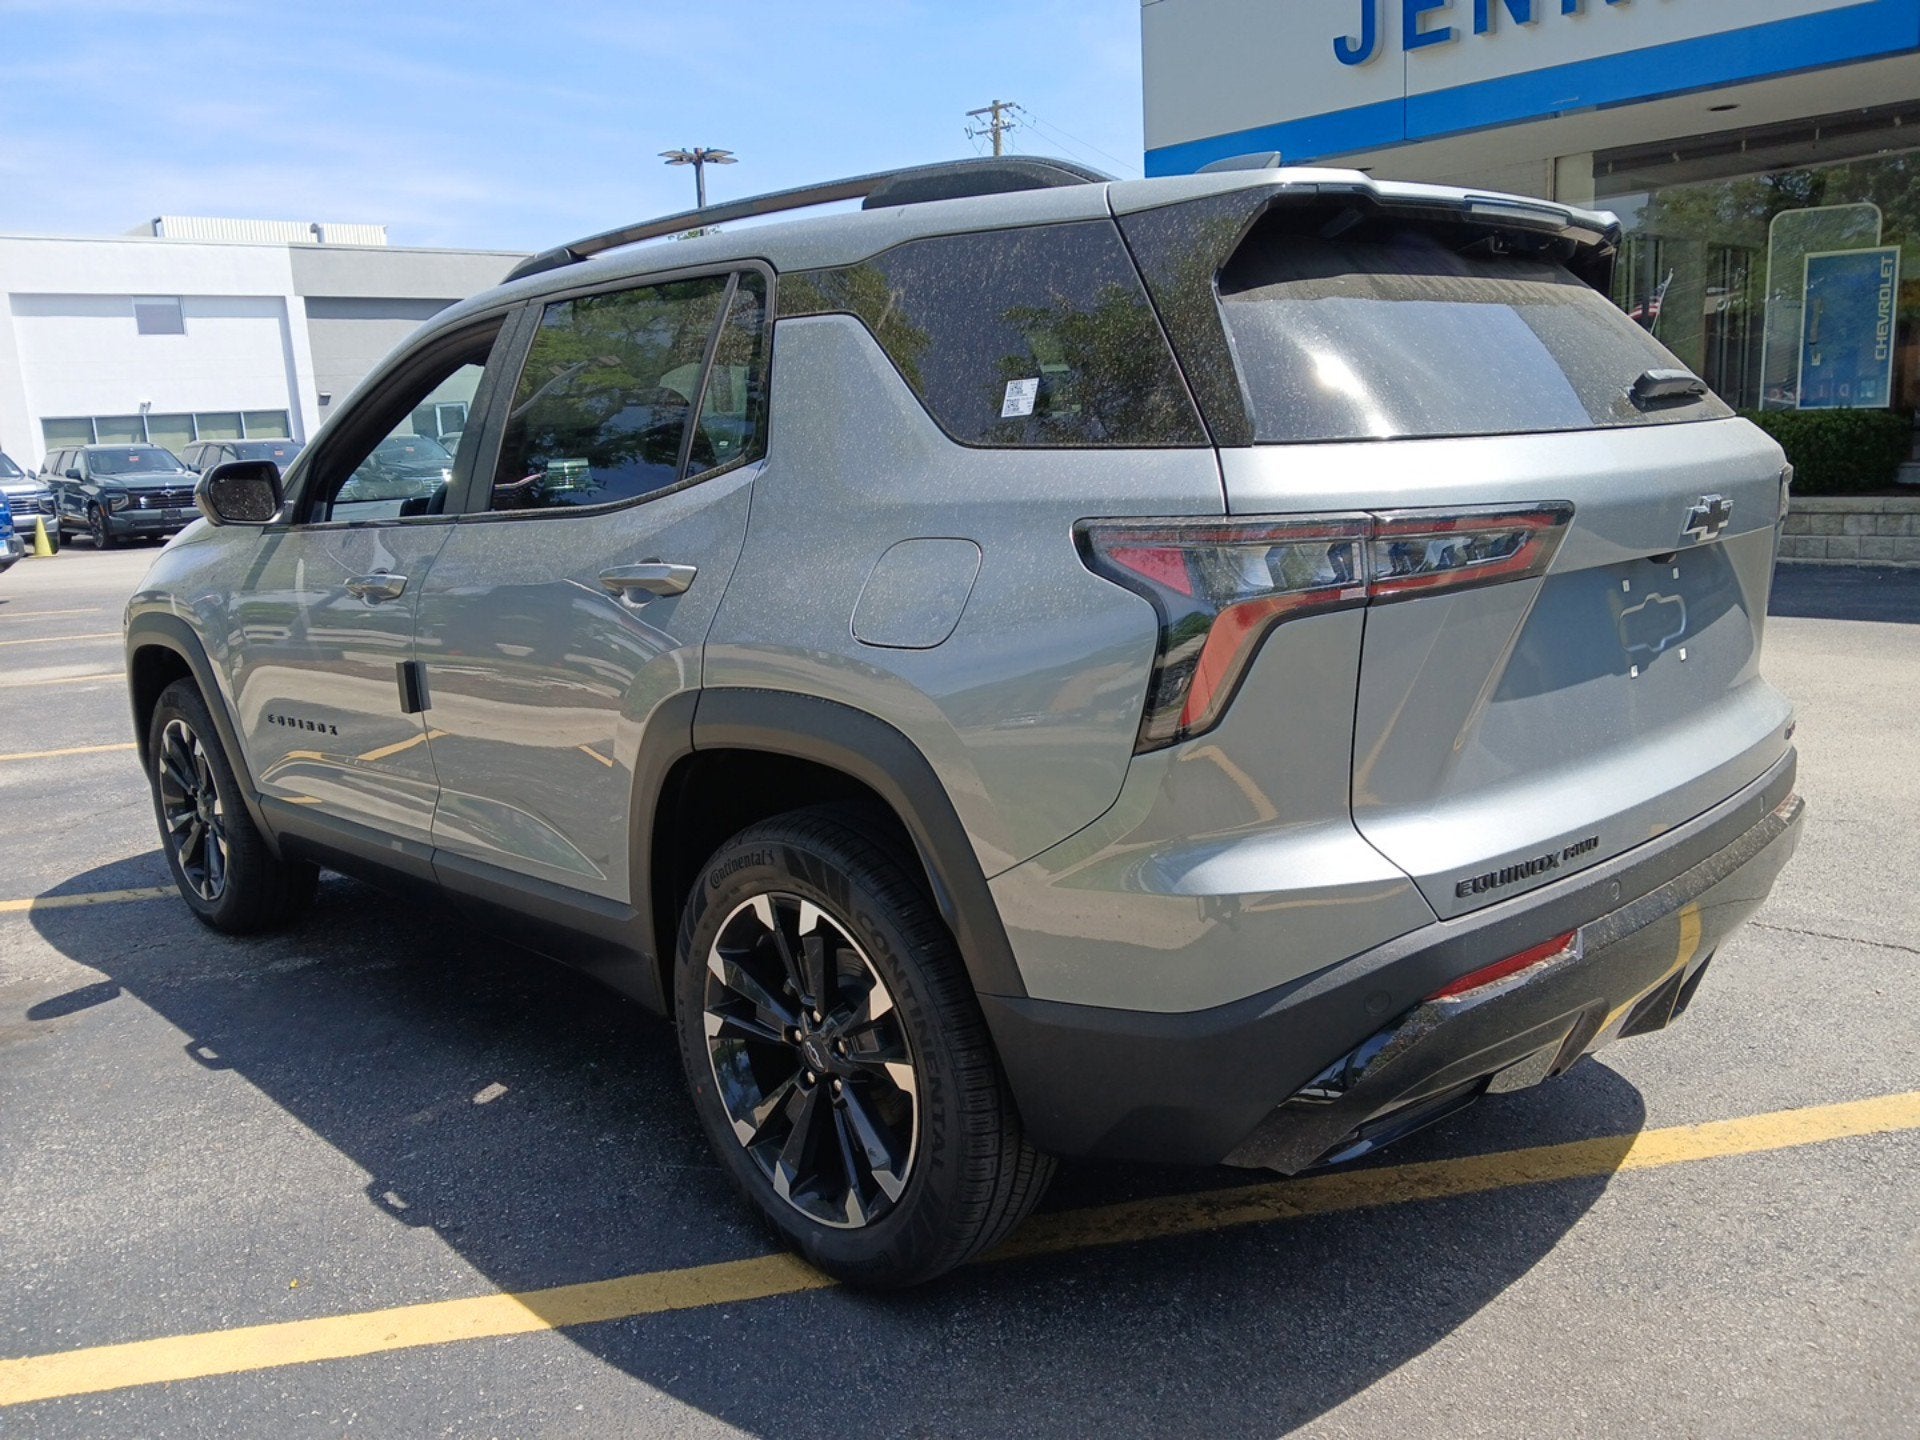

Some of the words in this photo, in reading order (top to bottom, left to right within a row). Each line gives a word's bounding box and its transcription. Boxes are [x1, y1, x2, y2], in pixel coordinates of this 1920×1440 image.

[1875, 256, 1893, 361] CHEVROLET
[267, 713, 338, 736] EQUINOX
[709, 848, 766, 889] Continental
[1455, 851, 1560, 898] EQUINOX
[855, 910, 946, 1169] CONTINENTAL
